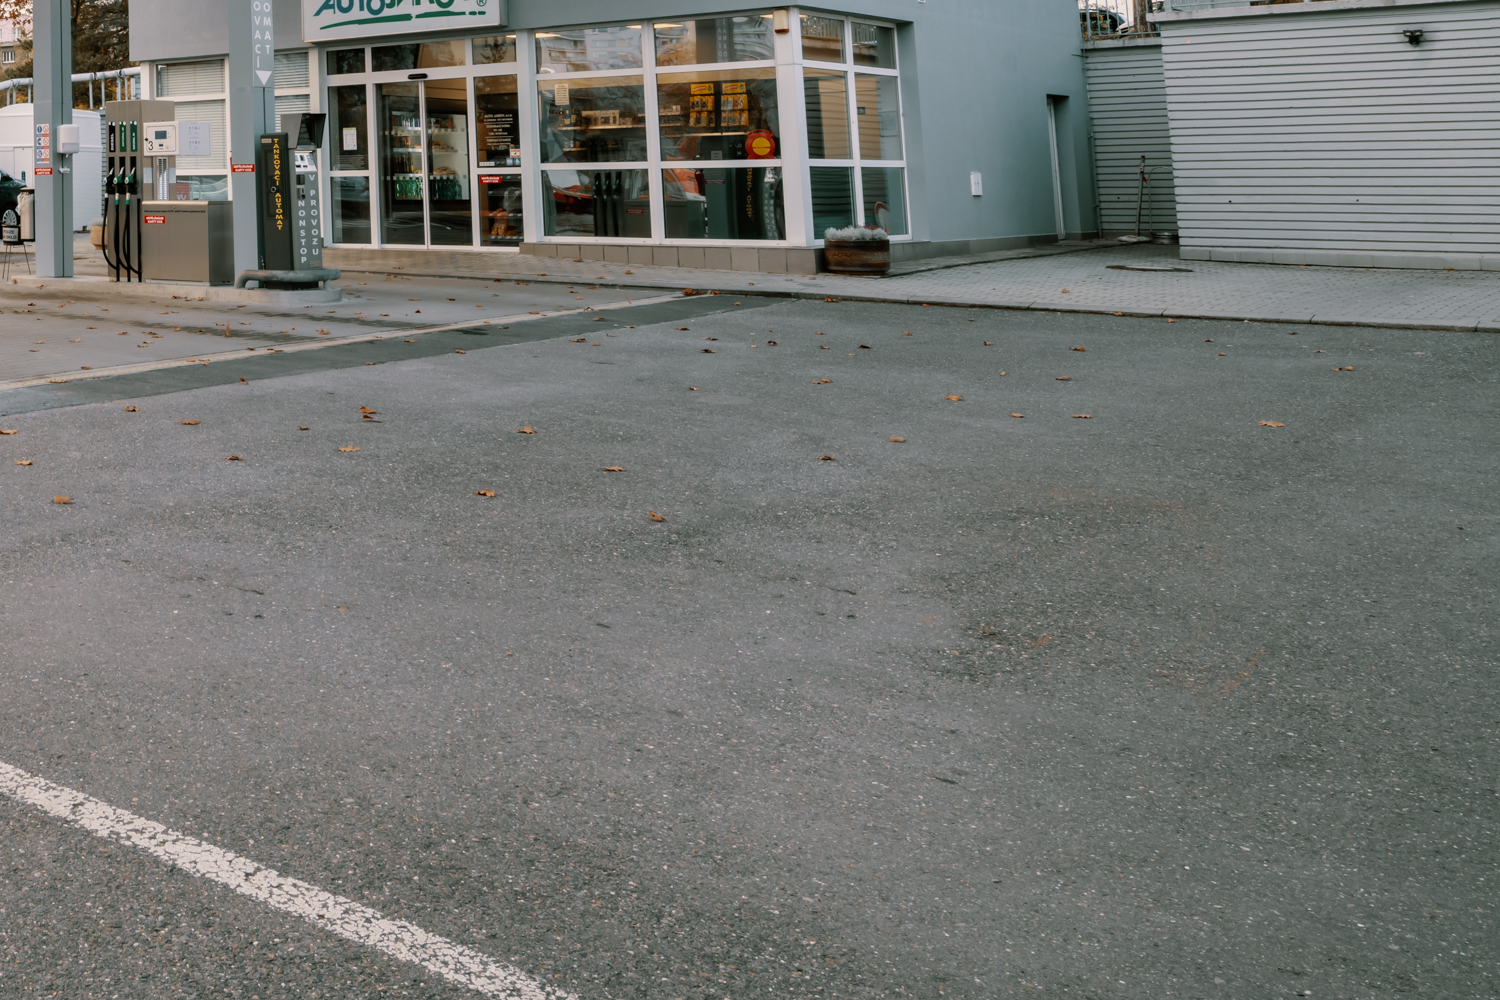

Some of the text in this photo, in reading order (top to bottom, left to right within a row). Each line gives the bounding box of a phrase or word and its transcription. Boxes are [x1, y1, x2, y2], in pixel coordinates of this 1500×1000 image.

[148, 141, 153, 150] 3
[275, 192, 283, 231] AUTOMAT
[298, 200, 307, 264] NONSTOP
[310, 190, 319, 255] PROVOZU
